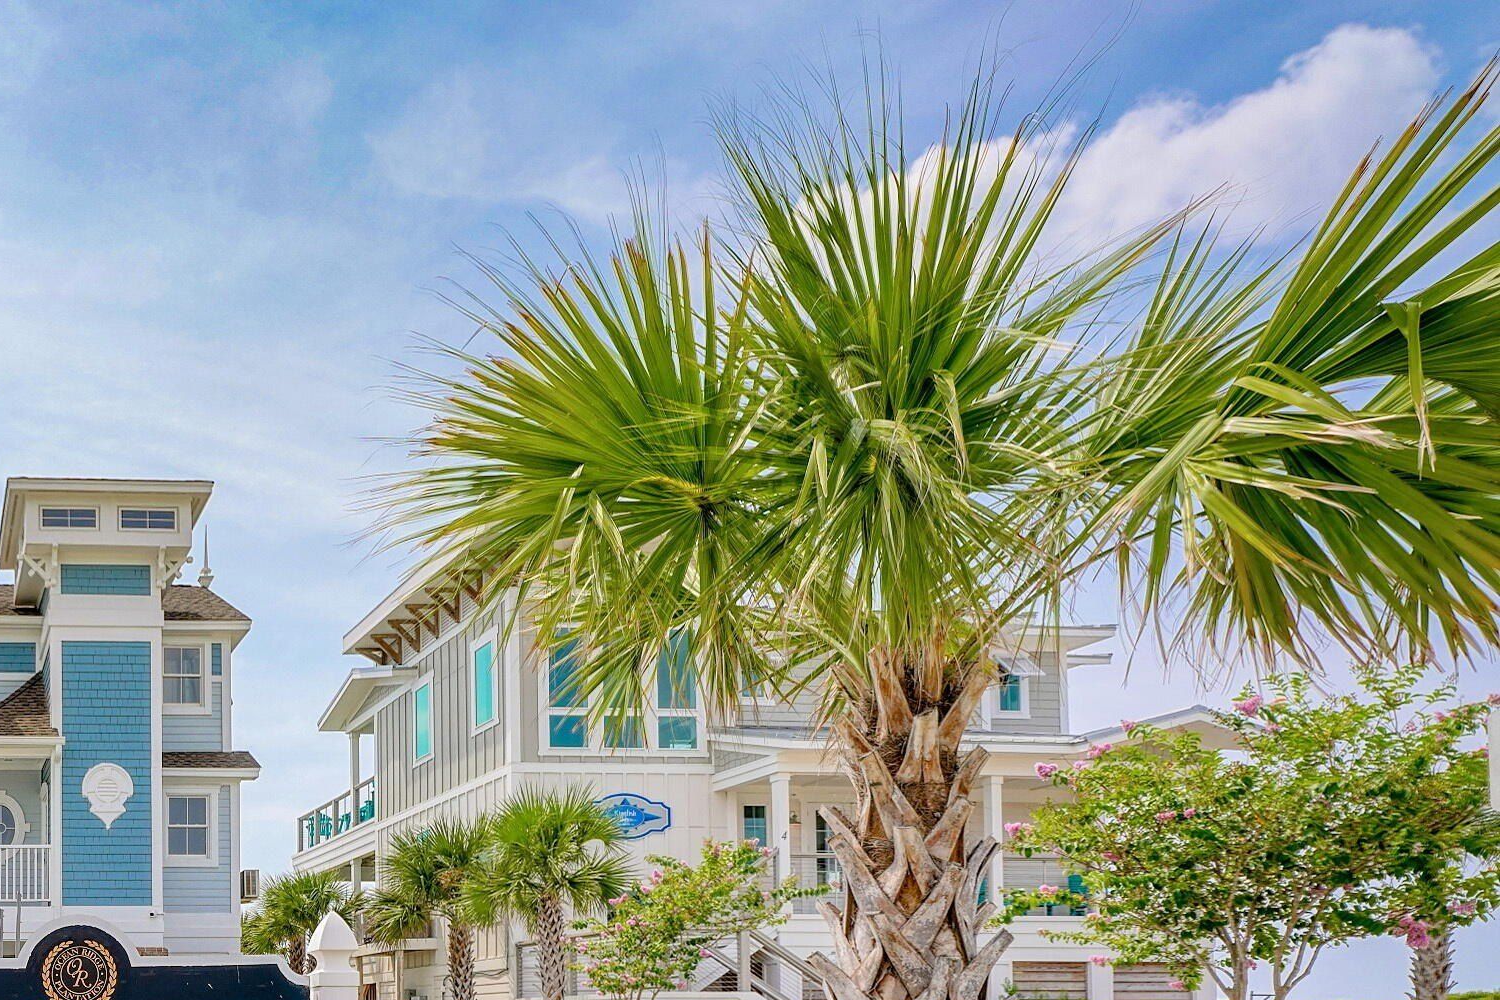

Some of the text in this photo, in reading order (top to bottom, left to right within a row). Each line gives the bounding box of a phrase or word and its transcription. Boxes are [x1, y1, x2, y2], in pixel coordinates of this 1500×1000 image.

[780, 831, 787, 841] 4
[55, 948, 105, 971] OCEAN RIDGE
[55, 980, 104, 1000] PLANTATION
